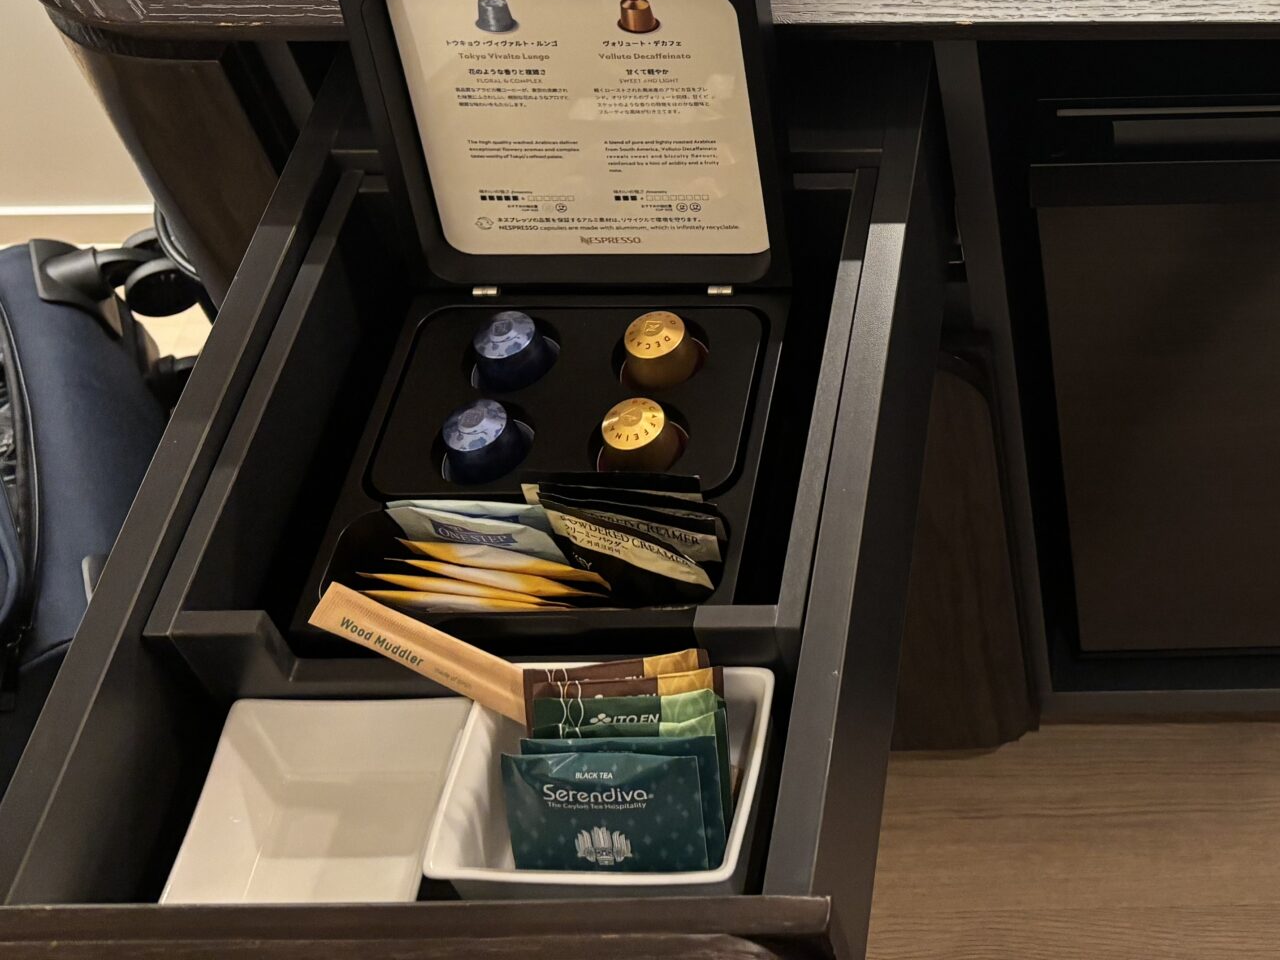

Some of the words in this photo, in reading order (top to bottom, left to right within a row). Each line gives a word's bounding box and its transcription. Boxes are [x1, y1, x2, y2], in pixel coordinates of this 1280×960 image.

[458, 53, 486, 61] Tokyo
[522, 53, 550, 61] Lungo
[579, 235, 641, 245] NESPRESSO
[637, 522, 700, 545] CREAMER
[632, 538, 694, 567] CREAMER
[340, 616, 373, 641] Wood
[374, 634, 424, 667] Muddler
[613, 715, 638, 724] ITO
[640, 714, 660, 724] EN
[575, 772, 598, 780] BLACK
[543, 784, 648, 803] Serendiva
[563, 802, 589, 810] Ceylon
[604, 801, 647, 810] Hospitality
